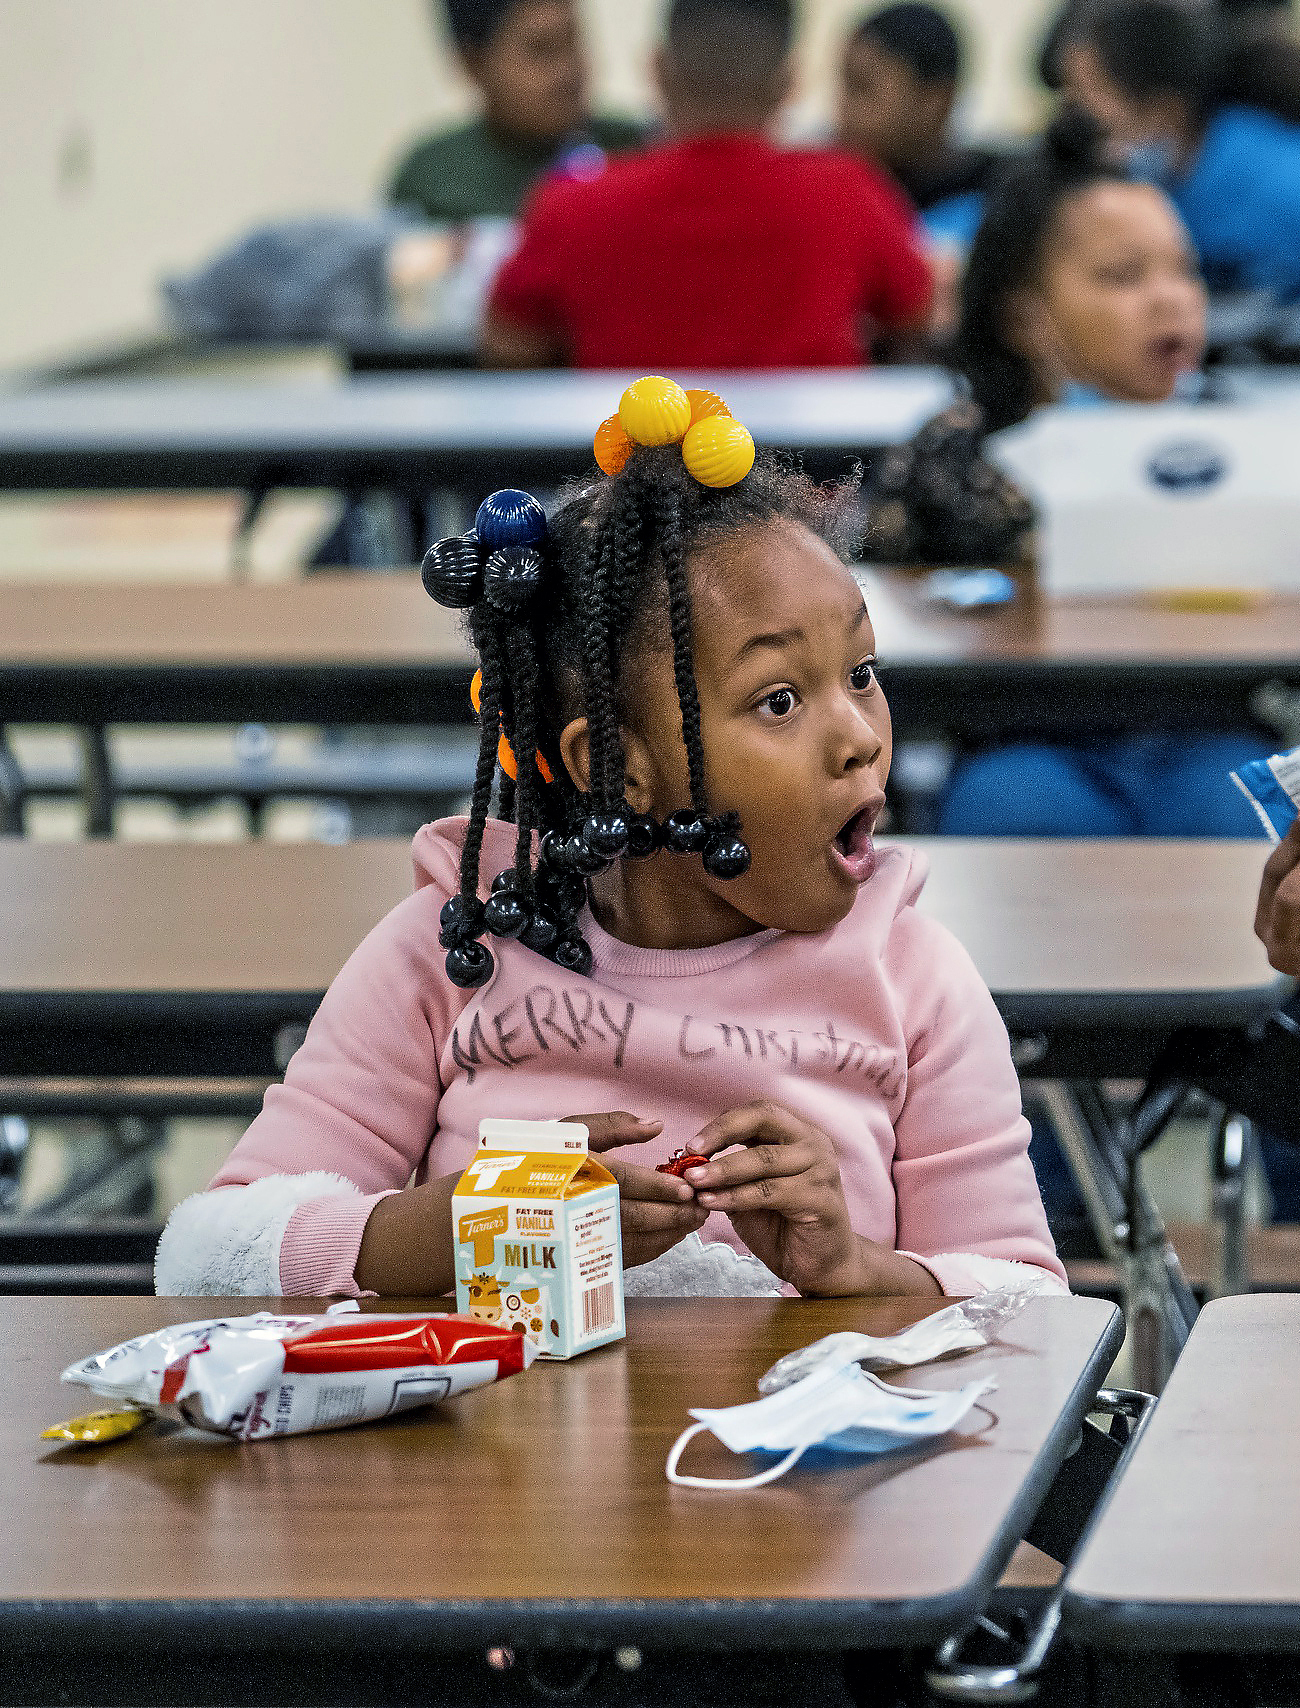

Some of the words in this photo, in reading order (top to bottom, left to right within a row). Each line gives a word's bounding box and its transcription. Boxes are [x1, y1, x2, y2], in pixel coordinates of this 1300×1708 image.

[452, 984, 635, 1086] MERRY
[529, 1172, 566, 1181] VANILLA
[500, 1186, 516, 1194] FAT
[462, 1213, 505, 1237] Turner's
[516, 1216, 555, 1230] VANILLA
[504, 1243, 557, 1269] MILK
[277, 1385, 294, 1414] CHIPS
